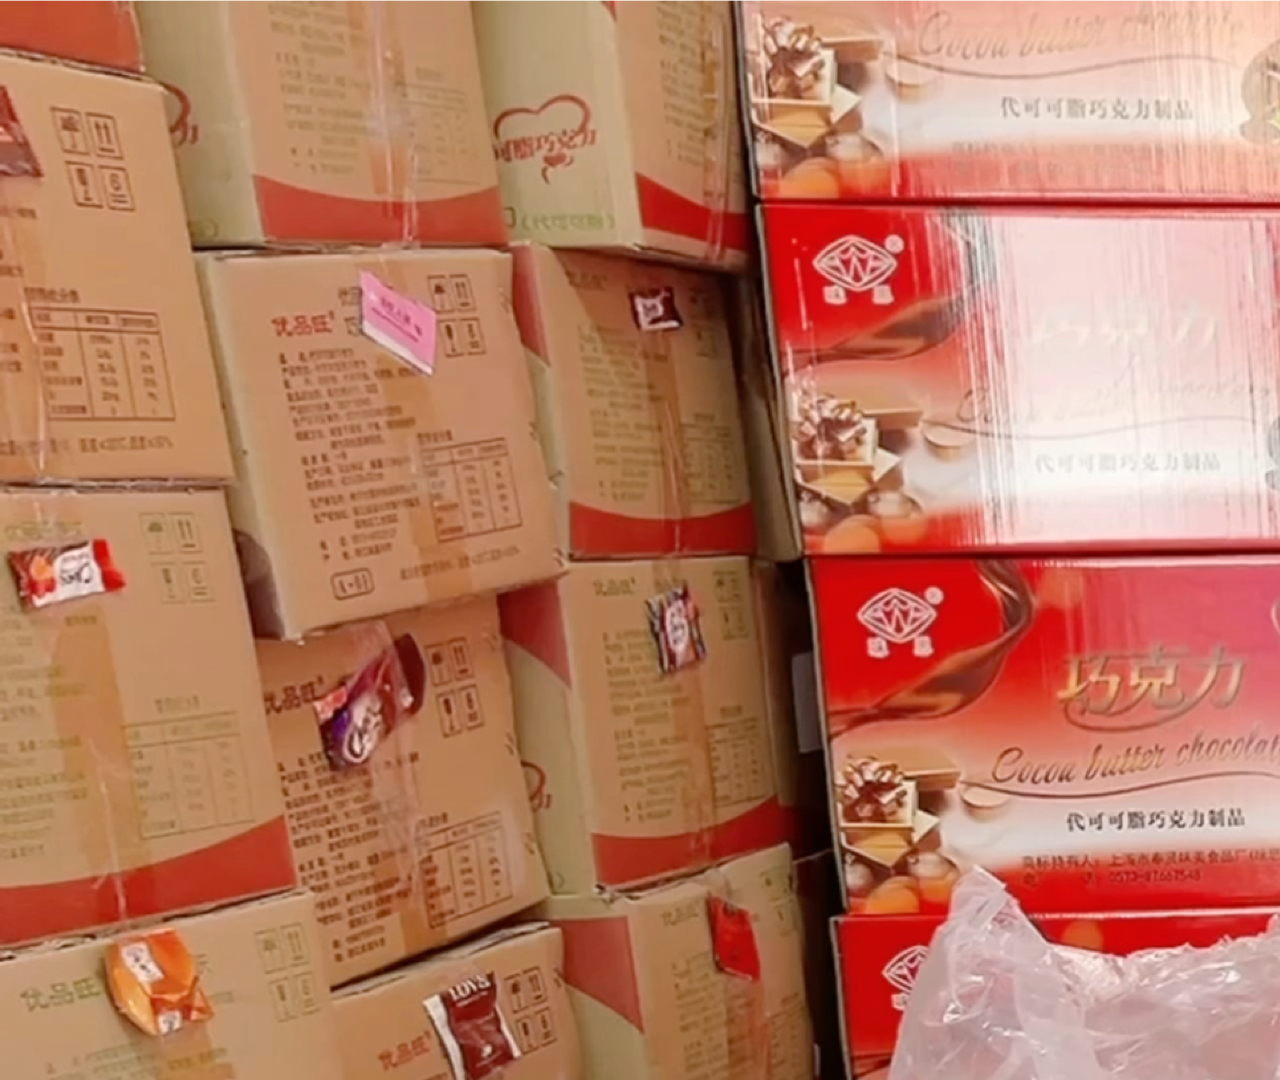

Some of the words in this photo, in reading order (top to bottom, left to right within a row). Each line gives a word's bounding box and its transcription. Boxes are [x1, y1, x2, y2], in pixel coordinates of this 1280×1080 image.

[1001, 95, 1195, 122] 代可可脂巧克力制品
[1058, 642, 1246, 714] 巧克力
[992, 744, 1076, 785] Cocoa
[1087, 740, 1165, 783] butter
[1066, 808, 1246, 833] 代可可脂巧克力制品
